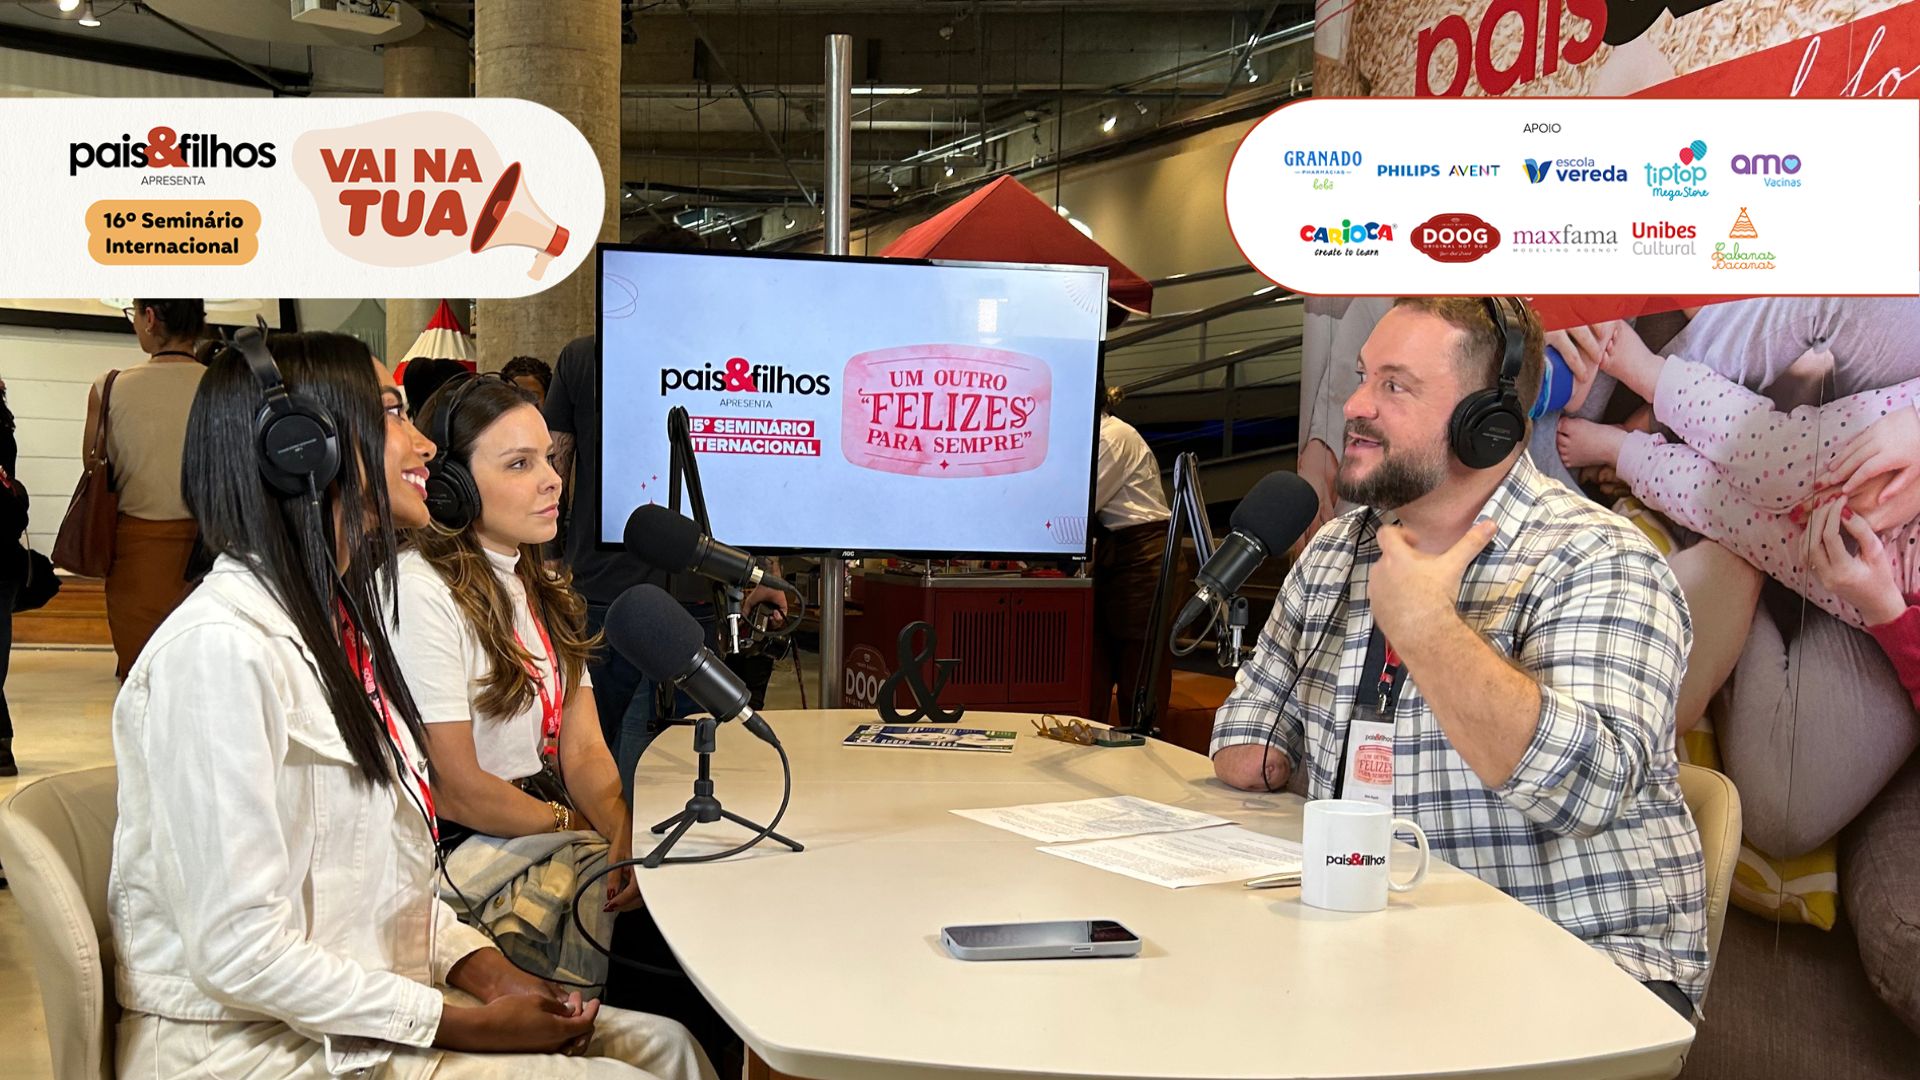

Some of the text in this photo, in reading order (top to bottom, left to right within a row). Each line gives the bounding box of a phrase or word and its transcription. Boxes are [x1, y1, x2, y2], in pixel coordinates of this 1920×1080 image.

[661, 358, 831, 396] pais&filhos
[889, 369, 1008, 391] UM OUTRO
[719, 398, 773, 409] APRESENTA
[713, 418, 811, 436] SEMINÁRIO
[866, 428, 923, 453] PARA
[1326, 853, 1385, 866] pais&filhos
